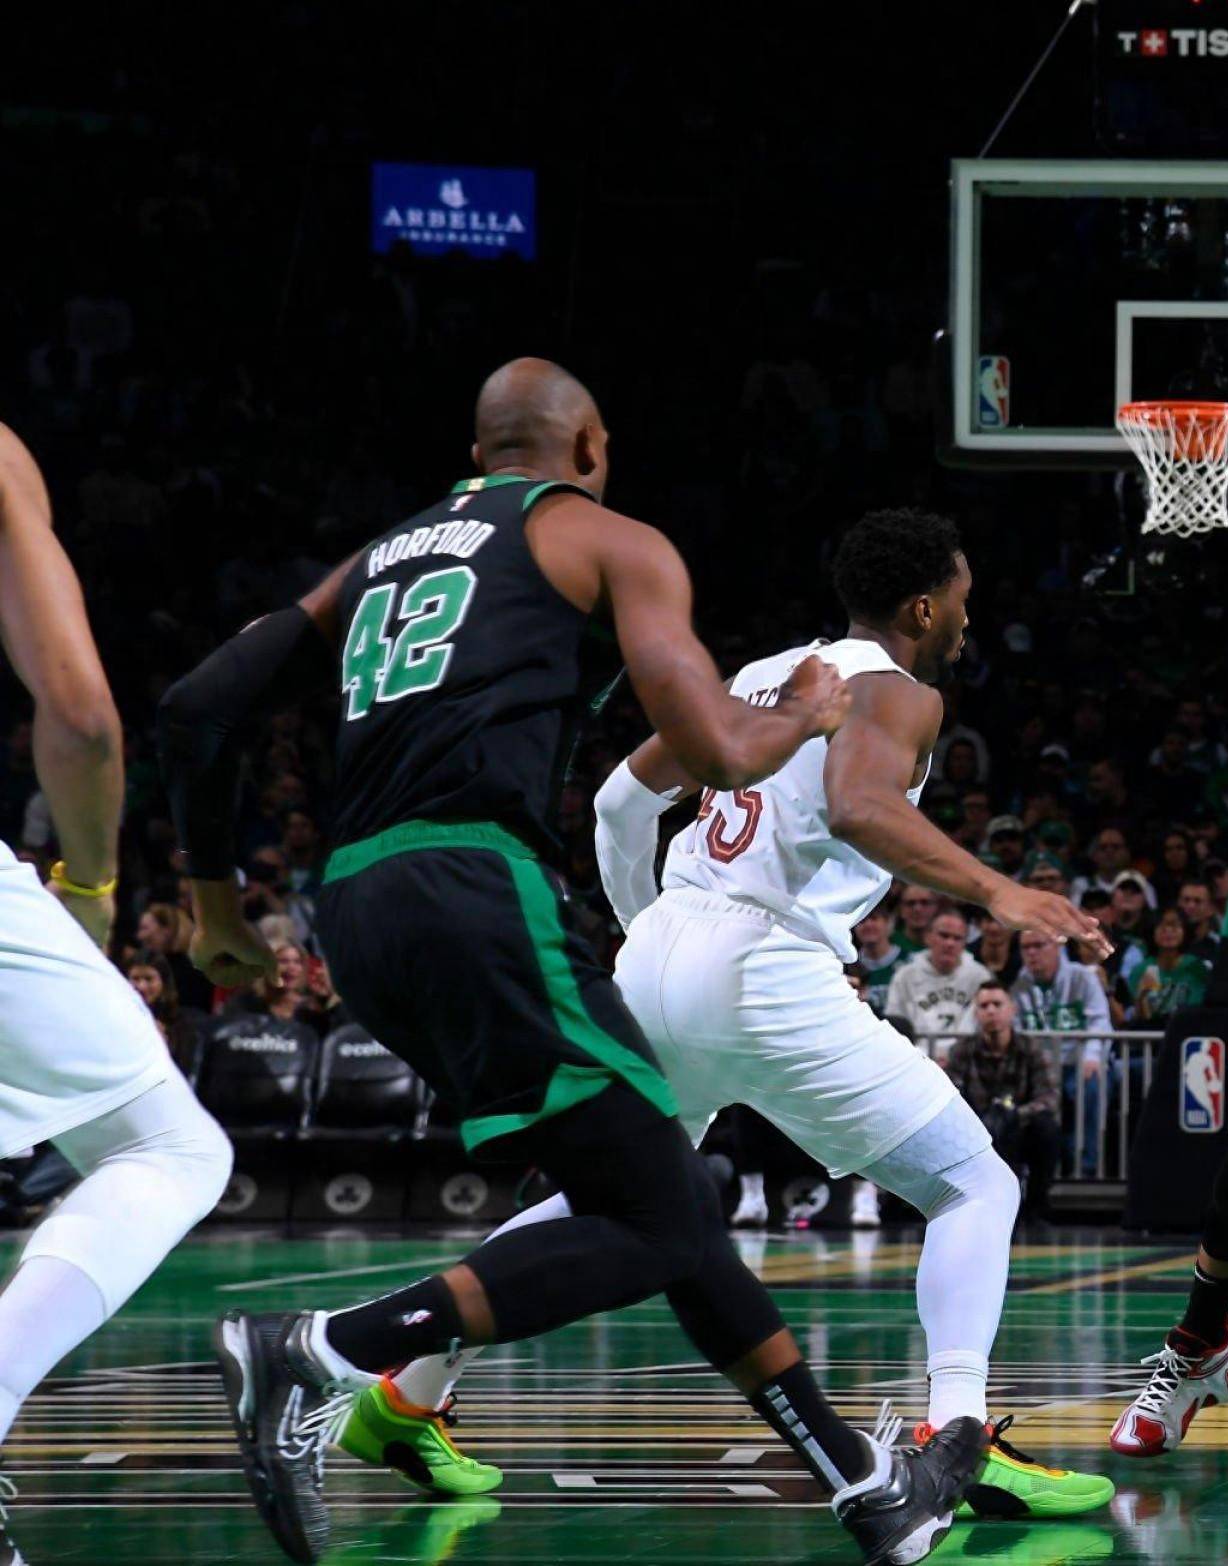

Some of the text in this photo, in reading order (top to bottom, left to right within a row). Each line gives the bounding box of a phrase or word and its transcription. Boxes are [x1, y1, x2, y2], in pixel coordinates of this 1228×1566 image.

[367, 518, 497, 578] HORFORD
[341, 565, 479, 722] 42
[699, 786, 764, 865] 5
